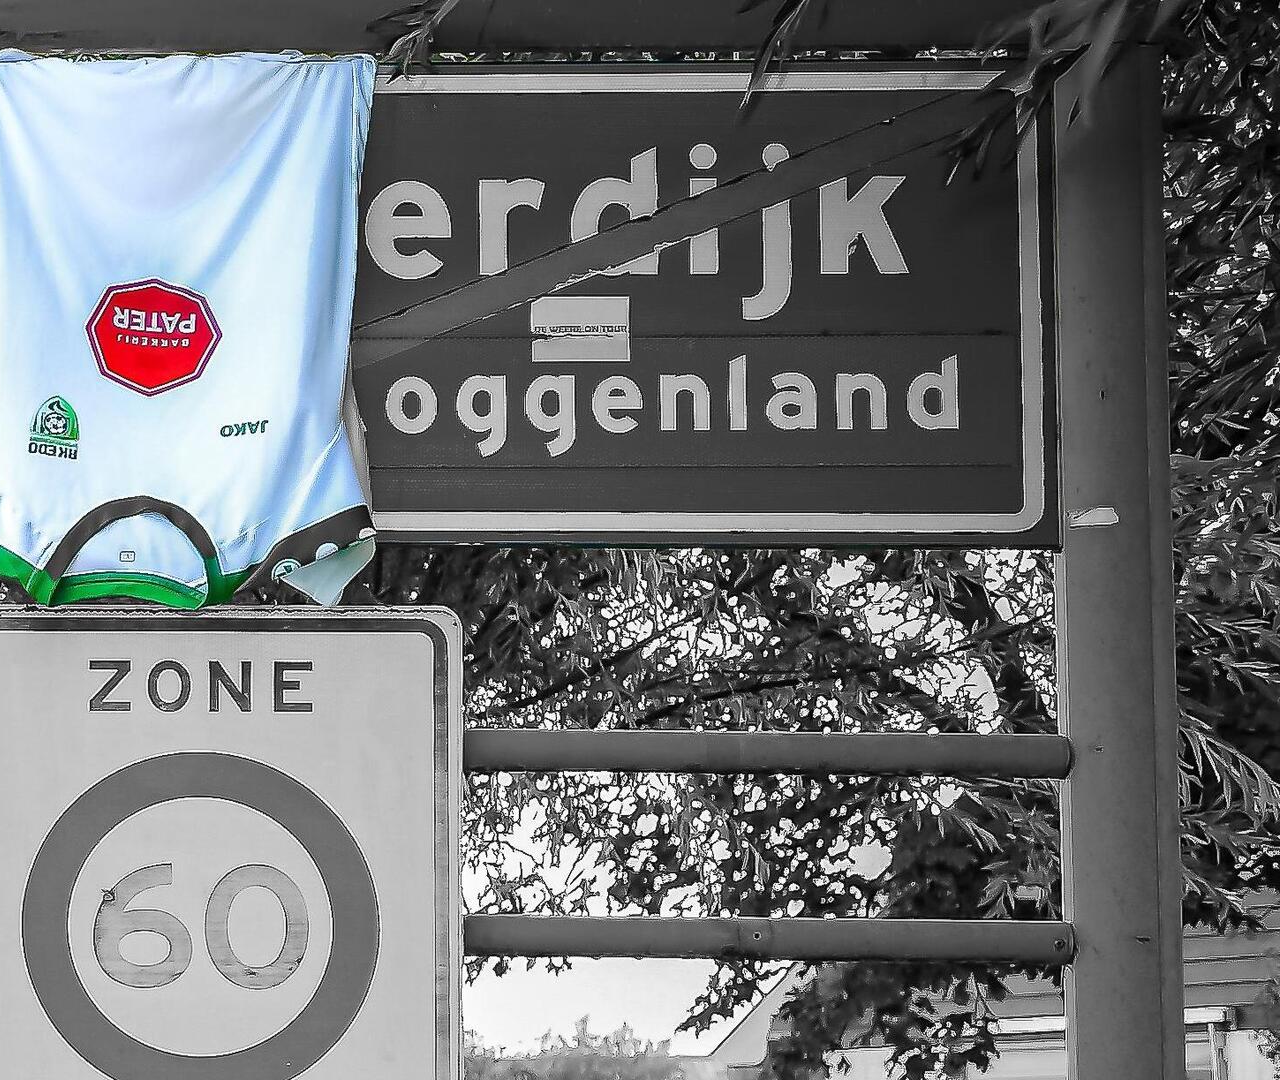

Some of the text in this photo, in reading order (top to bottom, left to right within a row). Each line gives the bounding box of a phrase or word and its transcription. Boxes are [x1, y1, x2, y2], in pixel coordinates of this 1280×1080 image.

[365, 143, 910, 321] erdijk
[112, 306, 198, 335] PATER
[220, 419, 269, 438] JAKO
[384, 354, 960, 458] oggenland
[28, 442, 78, 460] RKEDO
[89, 660, 313, 713] ZONE
[93, 863, 309, 988] 60
